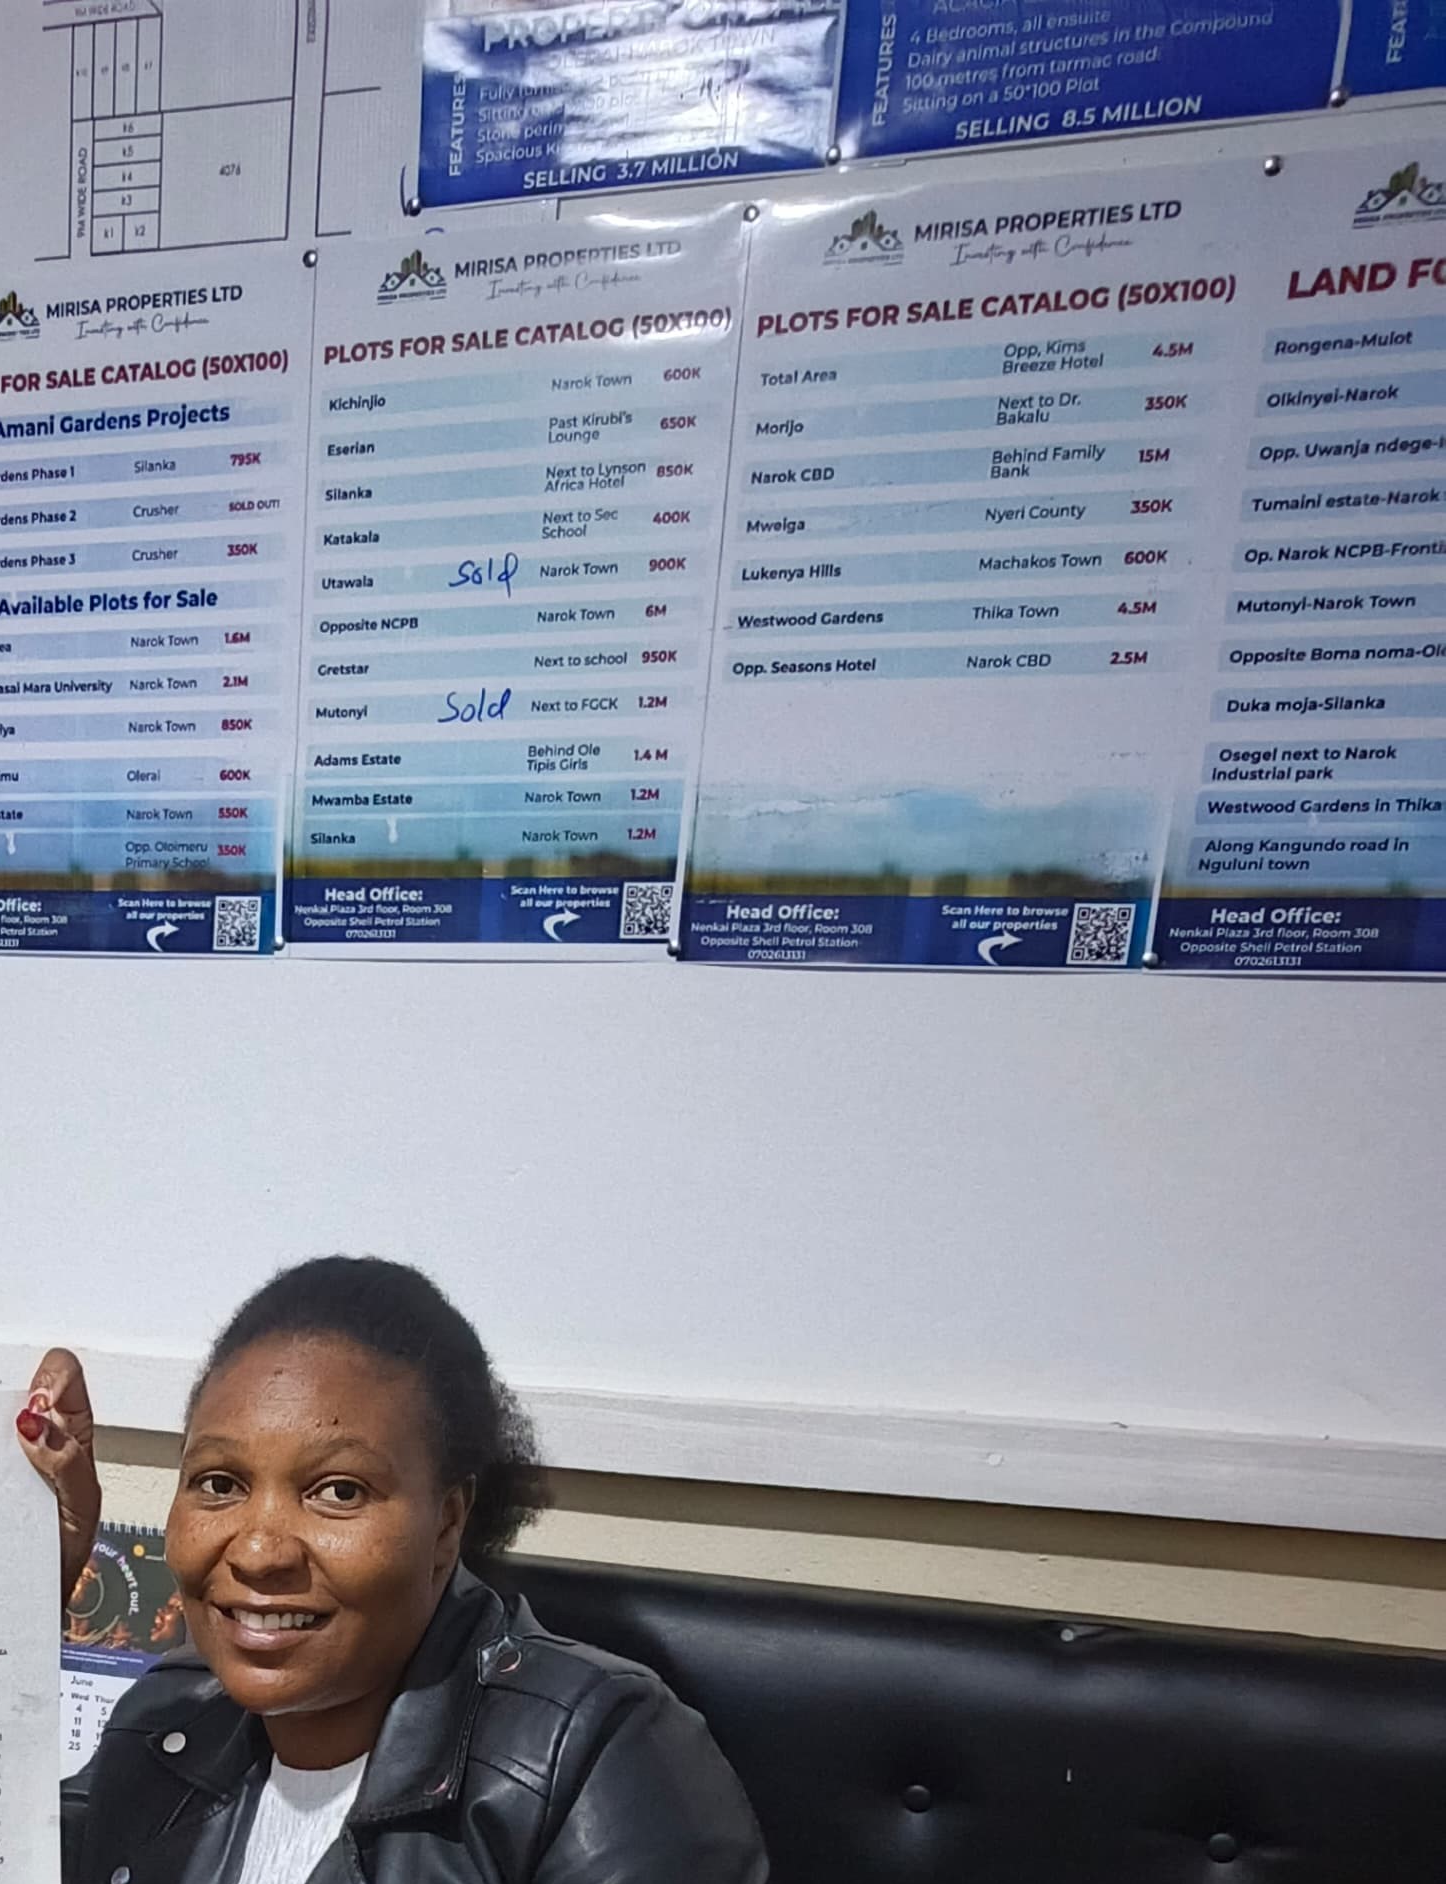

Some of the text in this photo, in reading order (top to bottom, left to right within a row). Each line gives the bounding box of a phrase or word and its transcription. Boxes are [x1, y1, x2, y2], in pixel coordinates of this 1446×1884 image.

[926, 15, 1041, 43] Bedrooms, all
[872, 13, 897, 126] FEATURES
[1002, 61, 1044, 79] from
[449, 74, 467, 176] FEATURES
[956, 95, 1202, 140] SELLING 8.5 MILLION
[523, 151, 739, 190] SELLING 3.7 MILLION
[914, 201, 1182, 243] MIRISA PROPERTIES LTD
[1288, 262, 1396, 300] LAND
[46, 285, 243, 319] MIRISA PROPERTIES LTD
[757, 275, 1236, 337] PLOTS FOR SALE CATALOG (50X100)
[1275, 331, 1412, 356] Rongena-Mulot
[1, 372, 40, 394] FOR
[46, 368, 95, 390] SALE
[102, 359, 196, 385] CATALOG
[202, 350, 288, 380] (50X100)
[761, 342, 1193, 387] Total Area 4.5M
[60, 409, 141, 434] Gardens
[148, 404, 230, 430] Projects
[756, 394, 1186, 438] Morijo 350K
[328, 415, 696, 456] Eserian Past 650K
[548, 429, 599, 445] Lounge
[1260, 440, 1369, 462] Opp. Uwanja
[32, 468, 66, 481] Phase
[135, 459, 176, 474] Silanka
[547, 461, 646, 480] Next to Lynson
[751, 445, 1170, 485] Narok CBD Behind Family 15M
[991, 464, 1029, 479] Bank
[545, 475, 625, 493] Africa Hotel
[133, 504, 179, 518] Crusher
[985, 499, 1172, 523] Nyeri County 350K
[324, 511, 690, 546] Katakala 400K
[321, 557, 686, 590] Utawala Narok Town 900K
[449, 552, 518, 597] Sold
[742, 550, 1167, 583] Lukenya Hills Machakos 600K
[90, 593, 138, 612] Plots
[144, 591, 172, 609] for
[176, 589, 217, 607] Sale
[1369, 596, 1416, 608] Town
[320, 617, 418, 634] Opposite NCPB
[738, 604, 1014, 630] Westwood Thika
[131, 635, 164, 648] Narok
[168, 633, 199, 646] Town
[585, 650, 677, 666] school 950K
[733, 657, 876, 678] Opp. Seasons Hotel
[437, 687, 513, 723] Sold
[1227, 699, 1270, 714] Duka
[314, 753, 401, 767] Adams Estate
[1345, 746, 1397, 760] Narok
[220, 769, 251, 781] 600K
[1295, 766, 1333, 783] park
[312, 793, 413, 807] Mwamba Estate
[1205, 838, 1409, 855] Along Kangundo road in
[1268, 858, 1310, 871] town
[726, 904, 840, 920] Head Office:
[952, 919, 1058, 932] all our properties
[1180, 941, 1236, 954] Opposite
[70, 1676, 93, 1686] June
